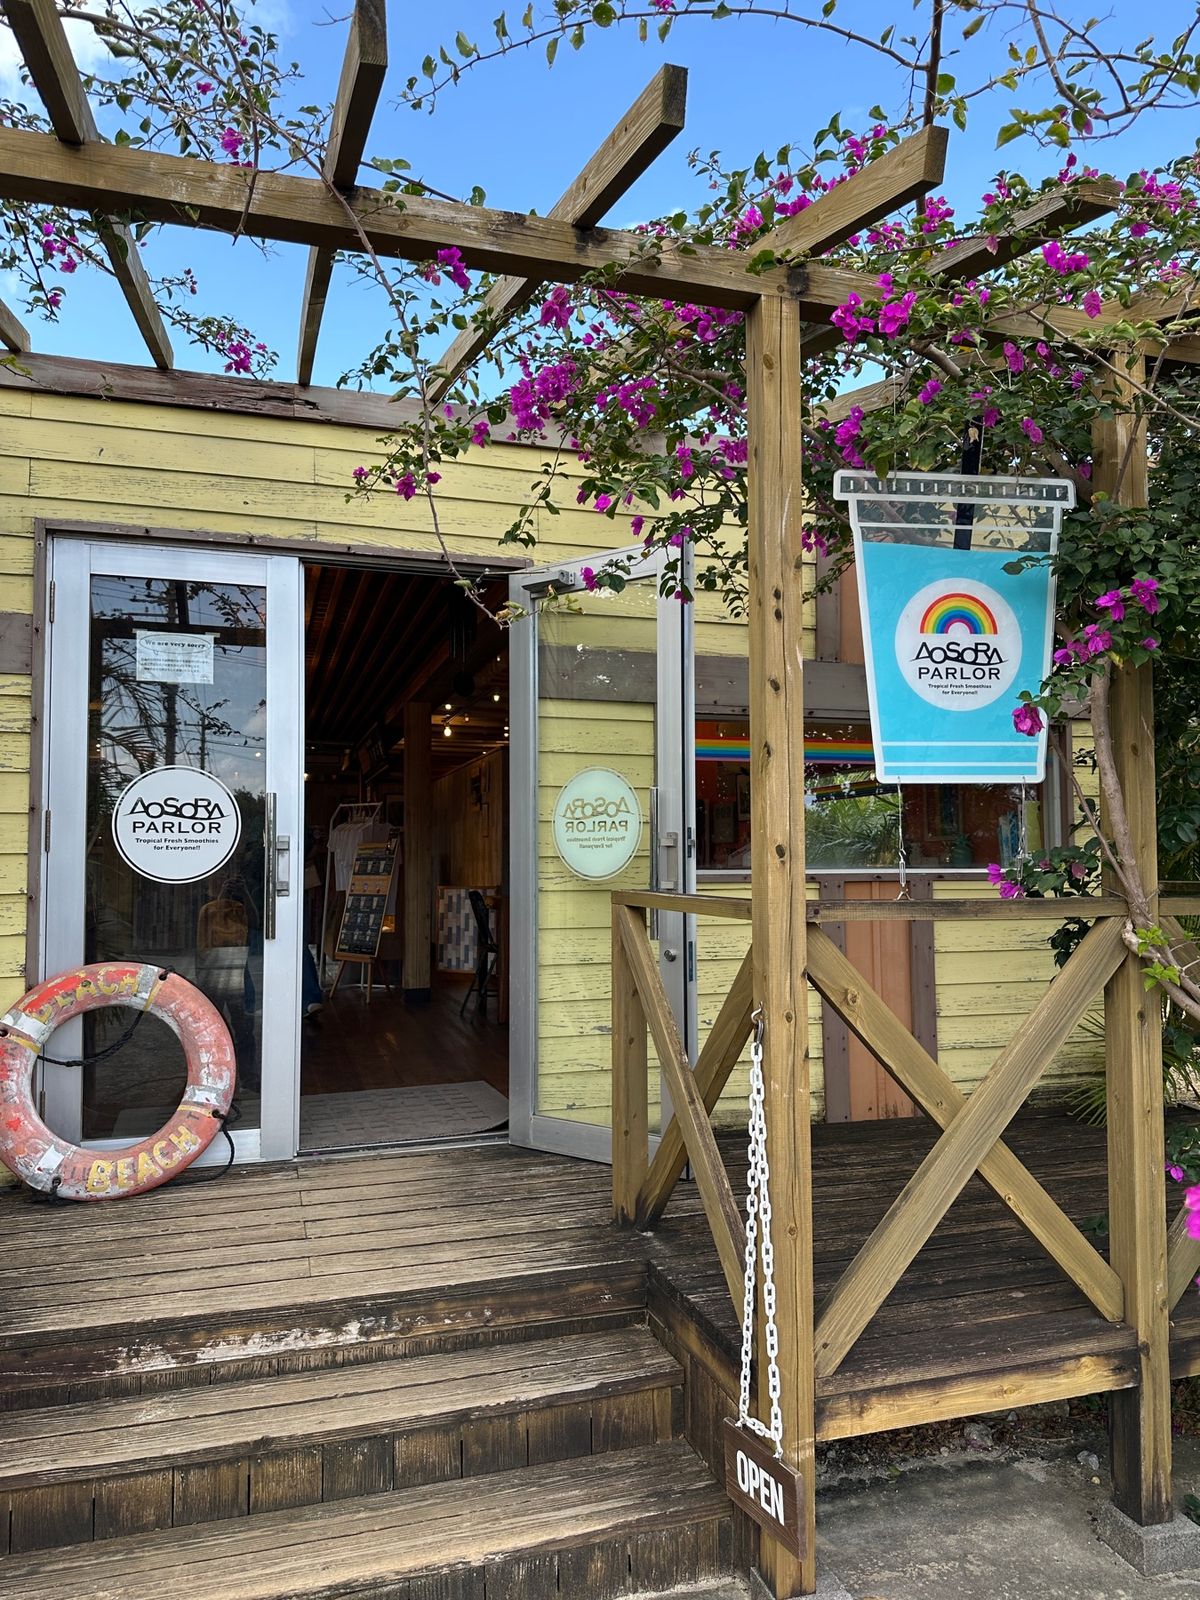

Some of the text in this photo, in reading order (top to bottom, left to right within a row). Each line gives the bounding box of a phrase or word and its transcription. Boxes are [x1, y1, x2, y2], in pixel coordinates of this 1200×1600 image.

[918, 667, 1001, 680] PARLOR
[132, 821, 221, 834] PARLOR
[135, 837, 163, 845] Tropical
[86, 1123, 201, 1193] BEACH
[736, 1450, 785, 1527] OPEN
